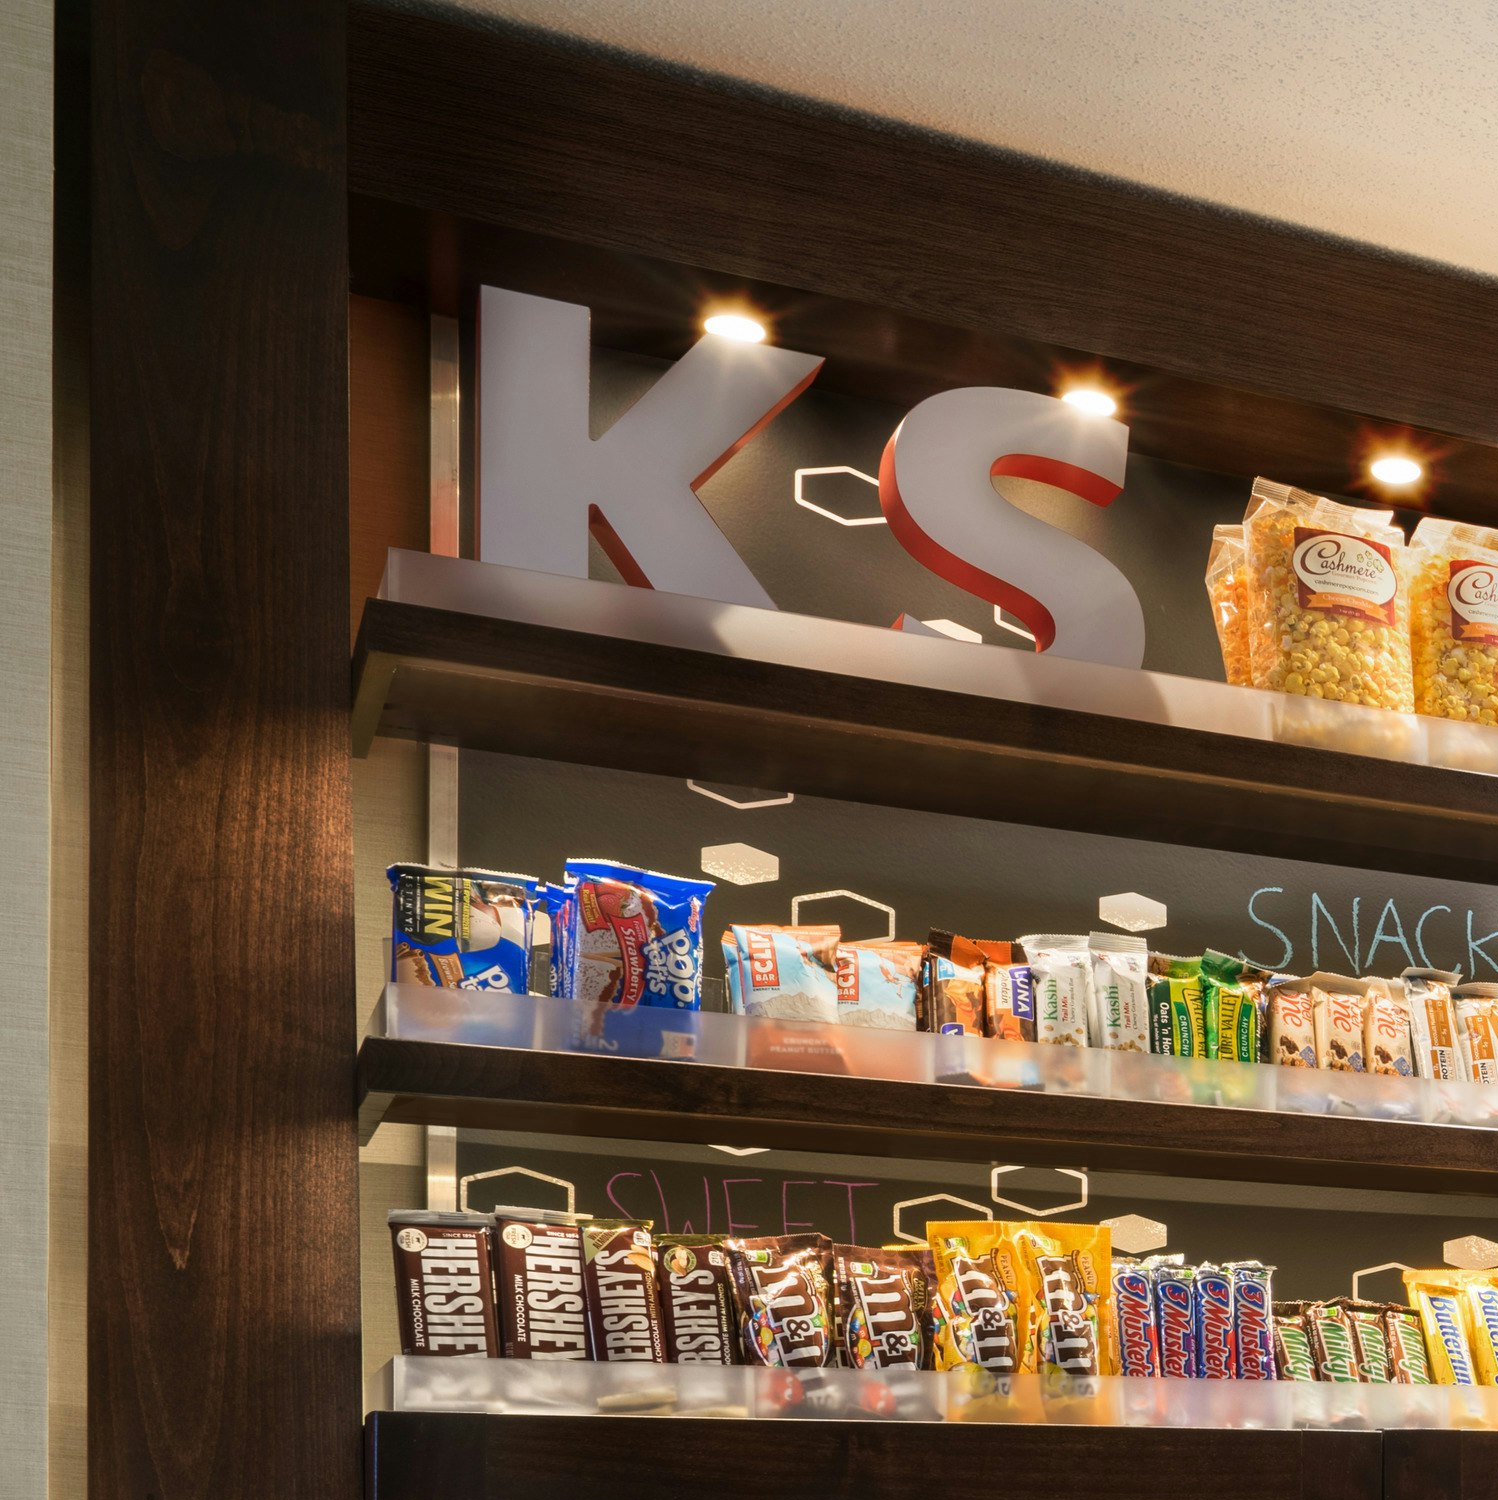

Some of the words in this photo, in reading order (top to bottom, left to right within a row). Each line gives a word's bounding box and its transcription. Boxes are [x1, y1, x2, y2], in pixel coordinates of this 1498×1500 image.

[1300, 540, 1377, 580] Cashmere
[423, 877, 453, 938] WIN
[619, 926, 639, 1002] Strawberry
[750, 932, 775, 974] CLIF
[756, 974, 775, 982] BAR
[1012, 967, 1033, 1018] LUNA
[1043, 978, 1058, 1022] Kashi
[1107, 984, 1119, 1028] Kashi
[1179, 1015, 1189, 1056] CRUNCHY
[606, 1169, 880, 1246] SWEET
[410, 1278, 419, 1299] MILK
[421, 1238, 488, 1358] HERSHE
[1123, 1276, 1145, 1296] 3
[411, 1300, 425, 1348] CHOCOLATE
